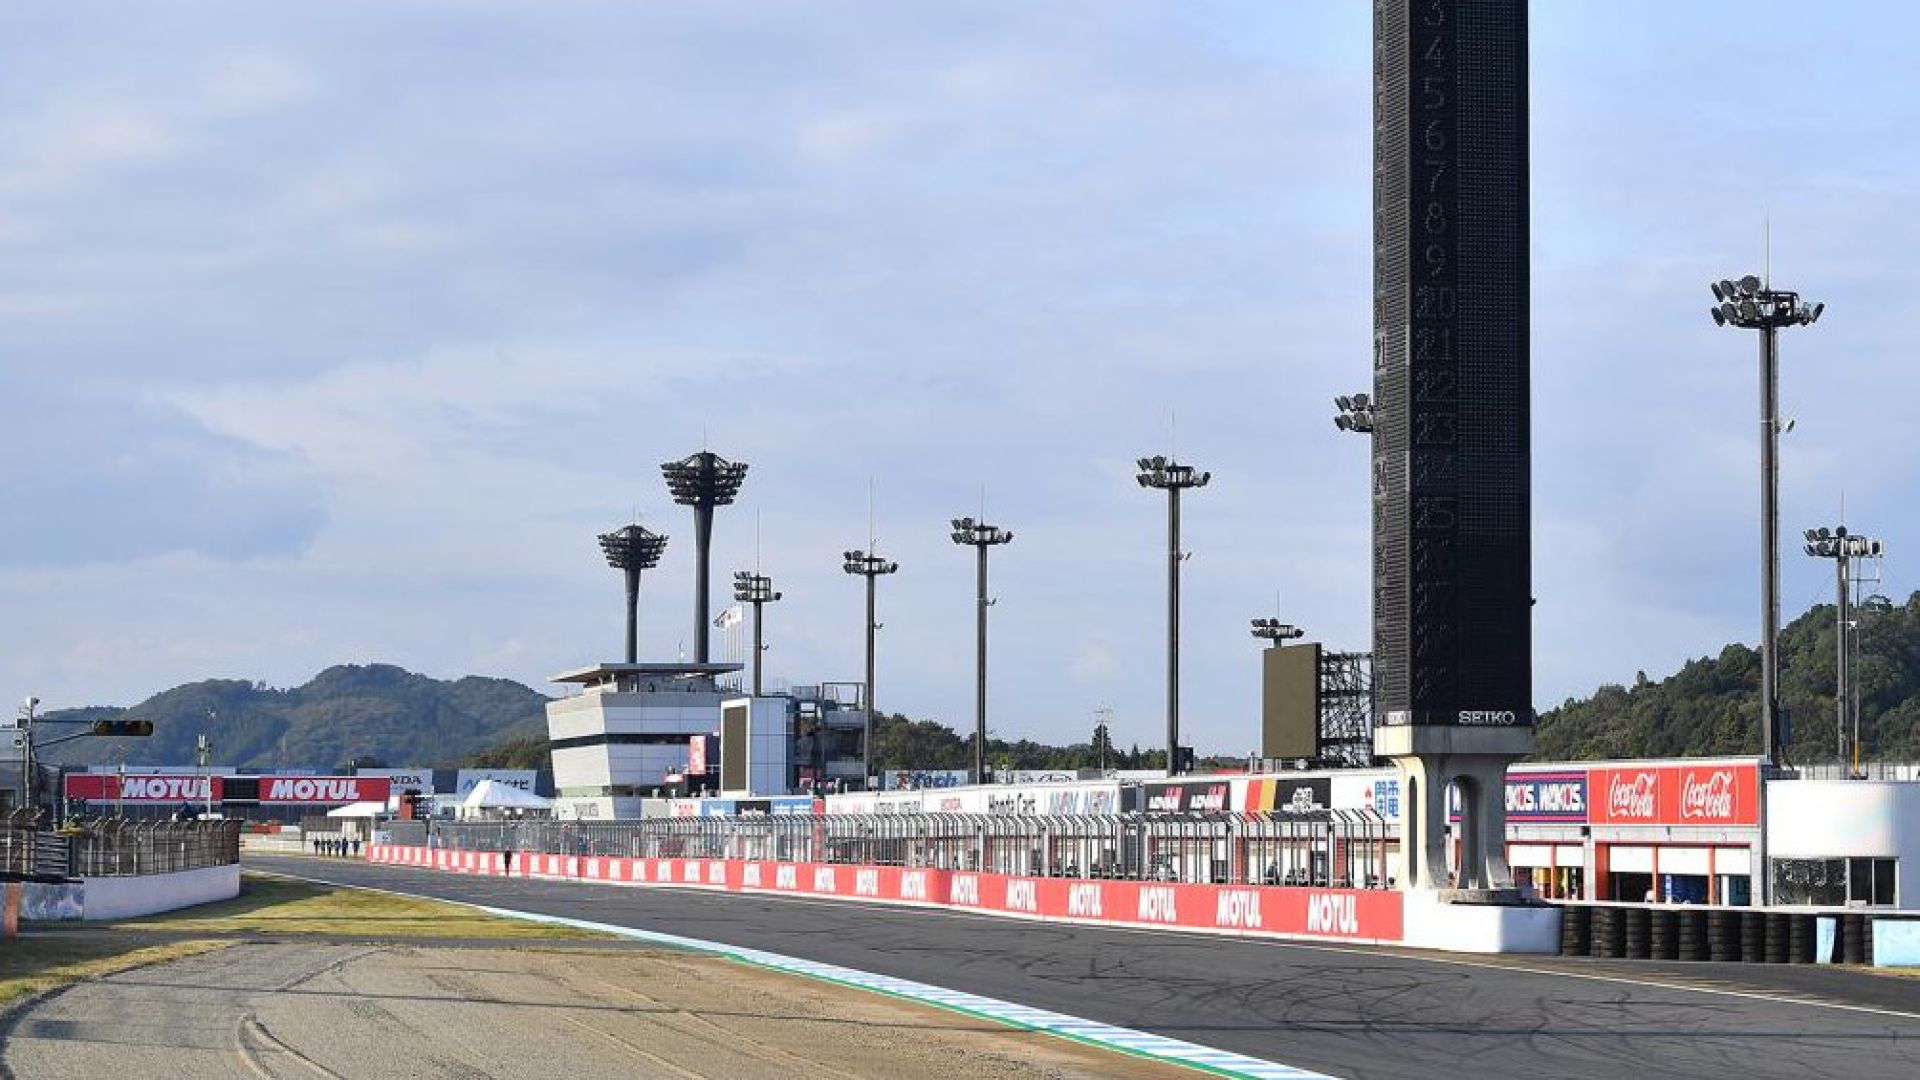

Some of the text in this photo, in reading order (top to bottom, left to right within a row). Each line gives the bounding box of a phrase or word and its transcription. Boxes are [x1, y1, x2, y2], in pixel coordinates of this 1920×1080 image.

[1424, 36, 1442, 68] 4
[1424, 77, 1445, 110] 5
[1424, 119, 1445, 151] 6
[1458, 711, 1515, 725] SEIKO
[123, 778, 360, 799] MOTUL MOTUL
[390, 776, 422, 785] NDA
[1138, 886, 1177, 922] MOTUL
[1216, 890, 1262, 928] MOTUL
[1308, 894, 1358, 933] MOTUL
